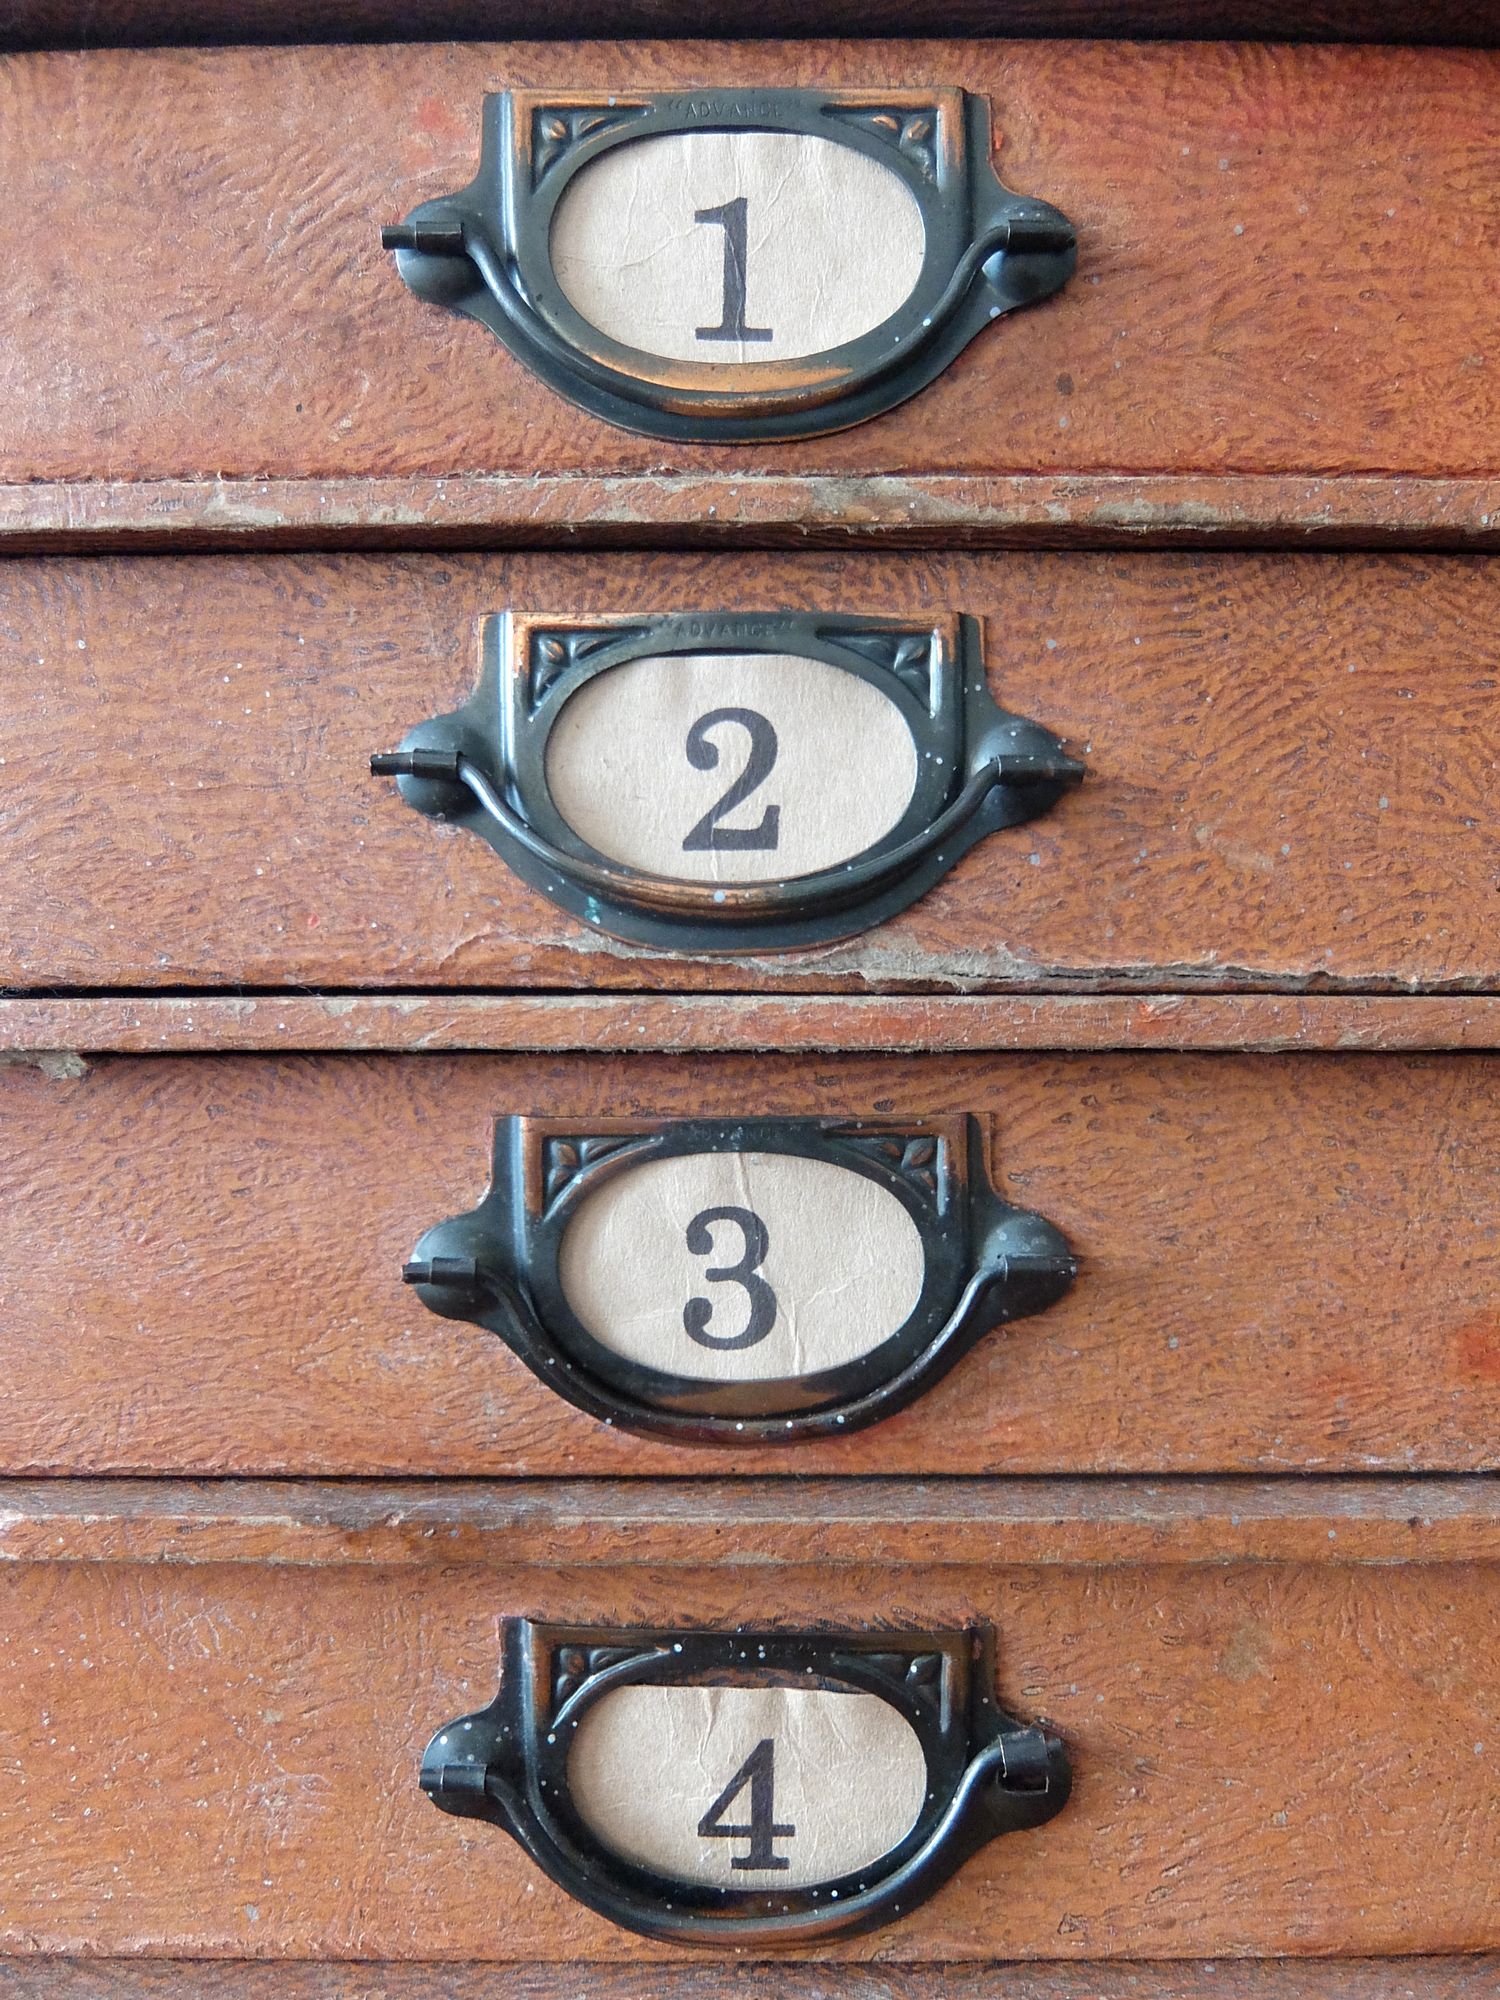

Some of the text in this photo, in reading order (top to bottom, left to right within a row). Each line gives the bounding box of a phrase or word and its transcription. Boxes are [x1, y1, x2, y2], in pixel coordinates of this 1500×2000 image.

[695, 197, 772, 340] 1
[683, 708, 779, 850] 2
[684, 1207, 777, 1350] 3
[698, 1739, 795, 1870] 4
